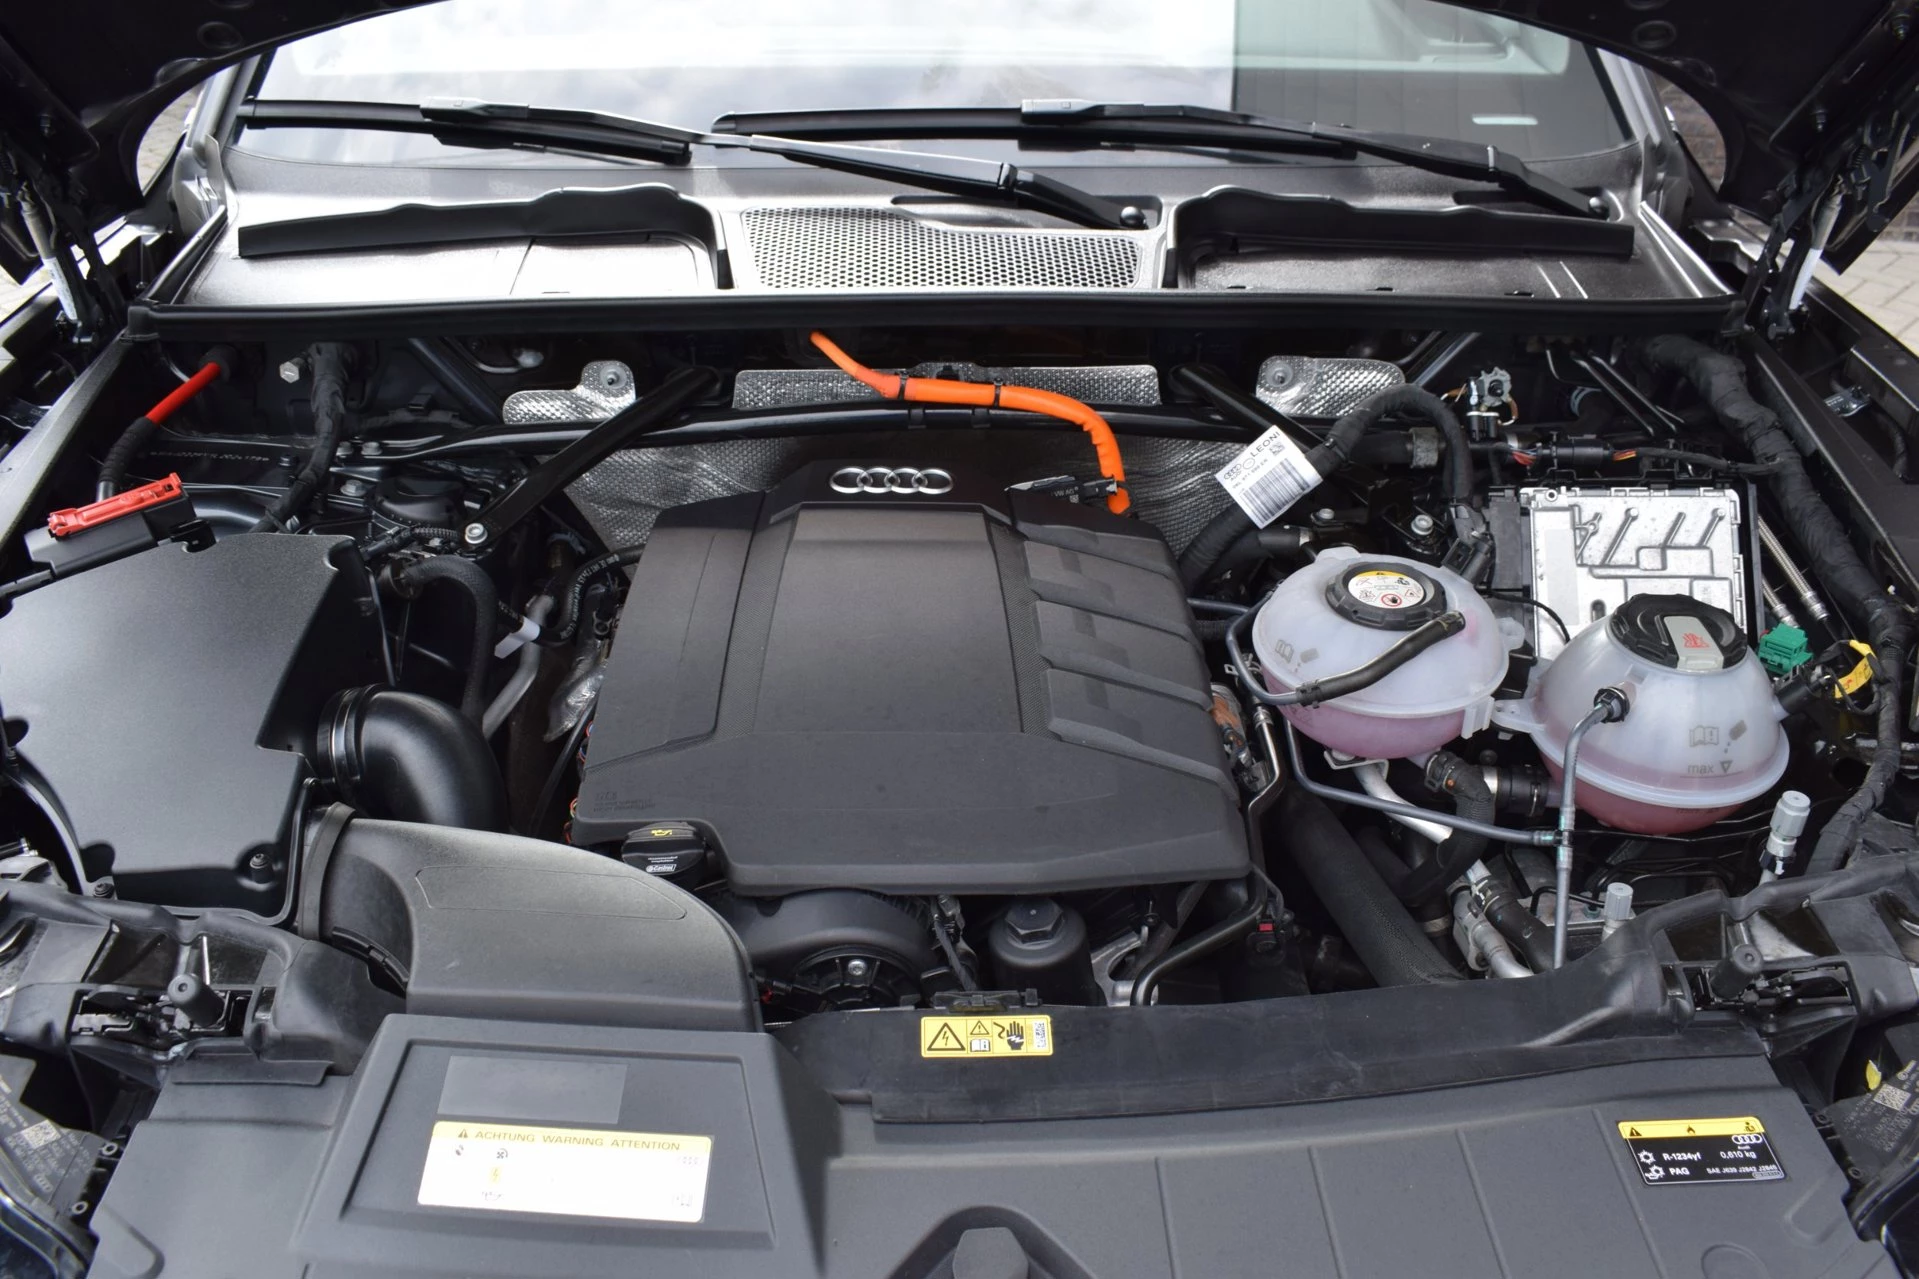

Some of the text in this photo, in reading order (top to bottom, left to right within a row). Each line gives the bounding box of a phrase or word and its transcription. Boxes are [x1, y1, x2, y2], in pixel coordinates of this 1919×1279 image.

[1250, 431, 1281, 457] LEONI
[1687, 764, 1714, 775] max
[475, 1130, 681, 1150] ACHTUNG WARNING ATTENTION
[1662, 1151, 1702, 1162] R-1234yf
[1744, 1150, 1757, 1160] kg
[1668, 1166, 1691, 1176] PAG
